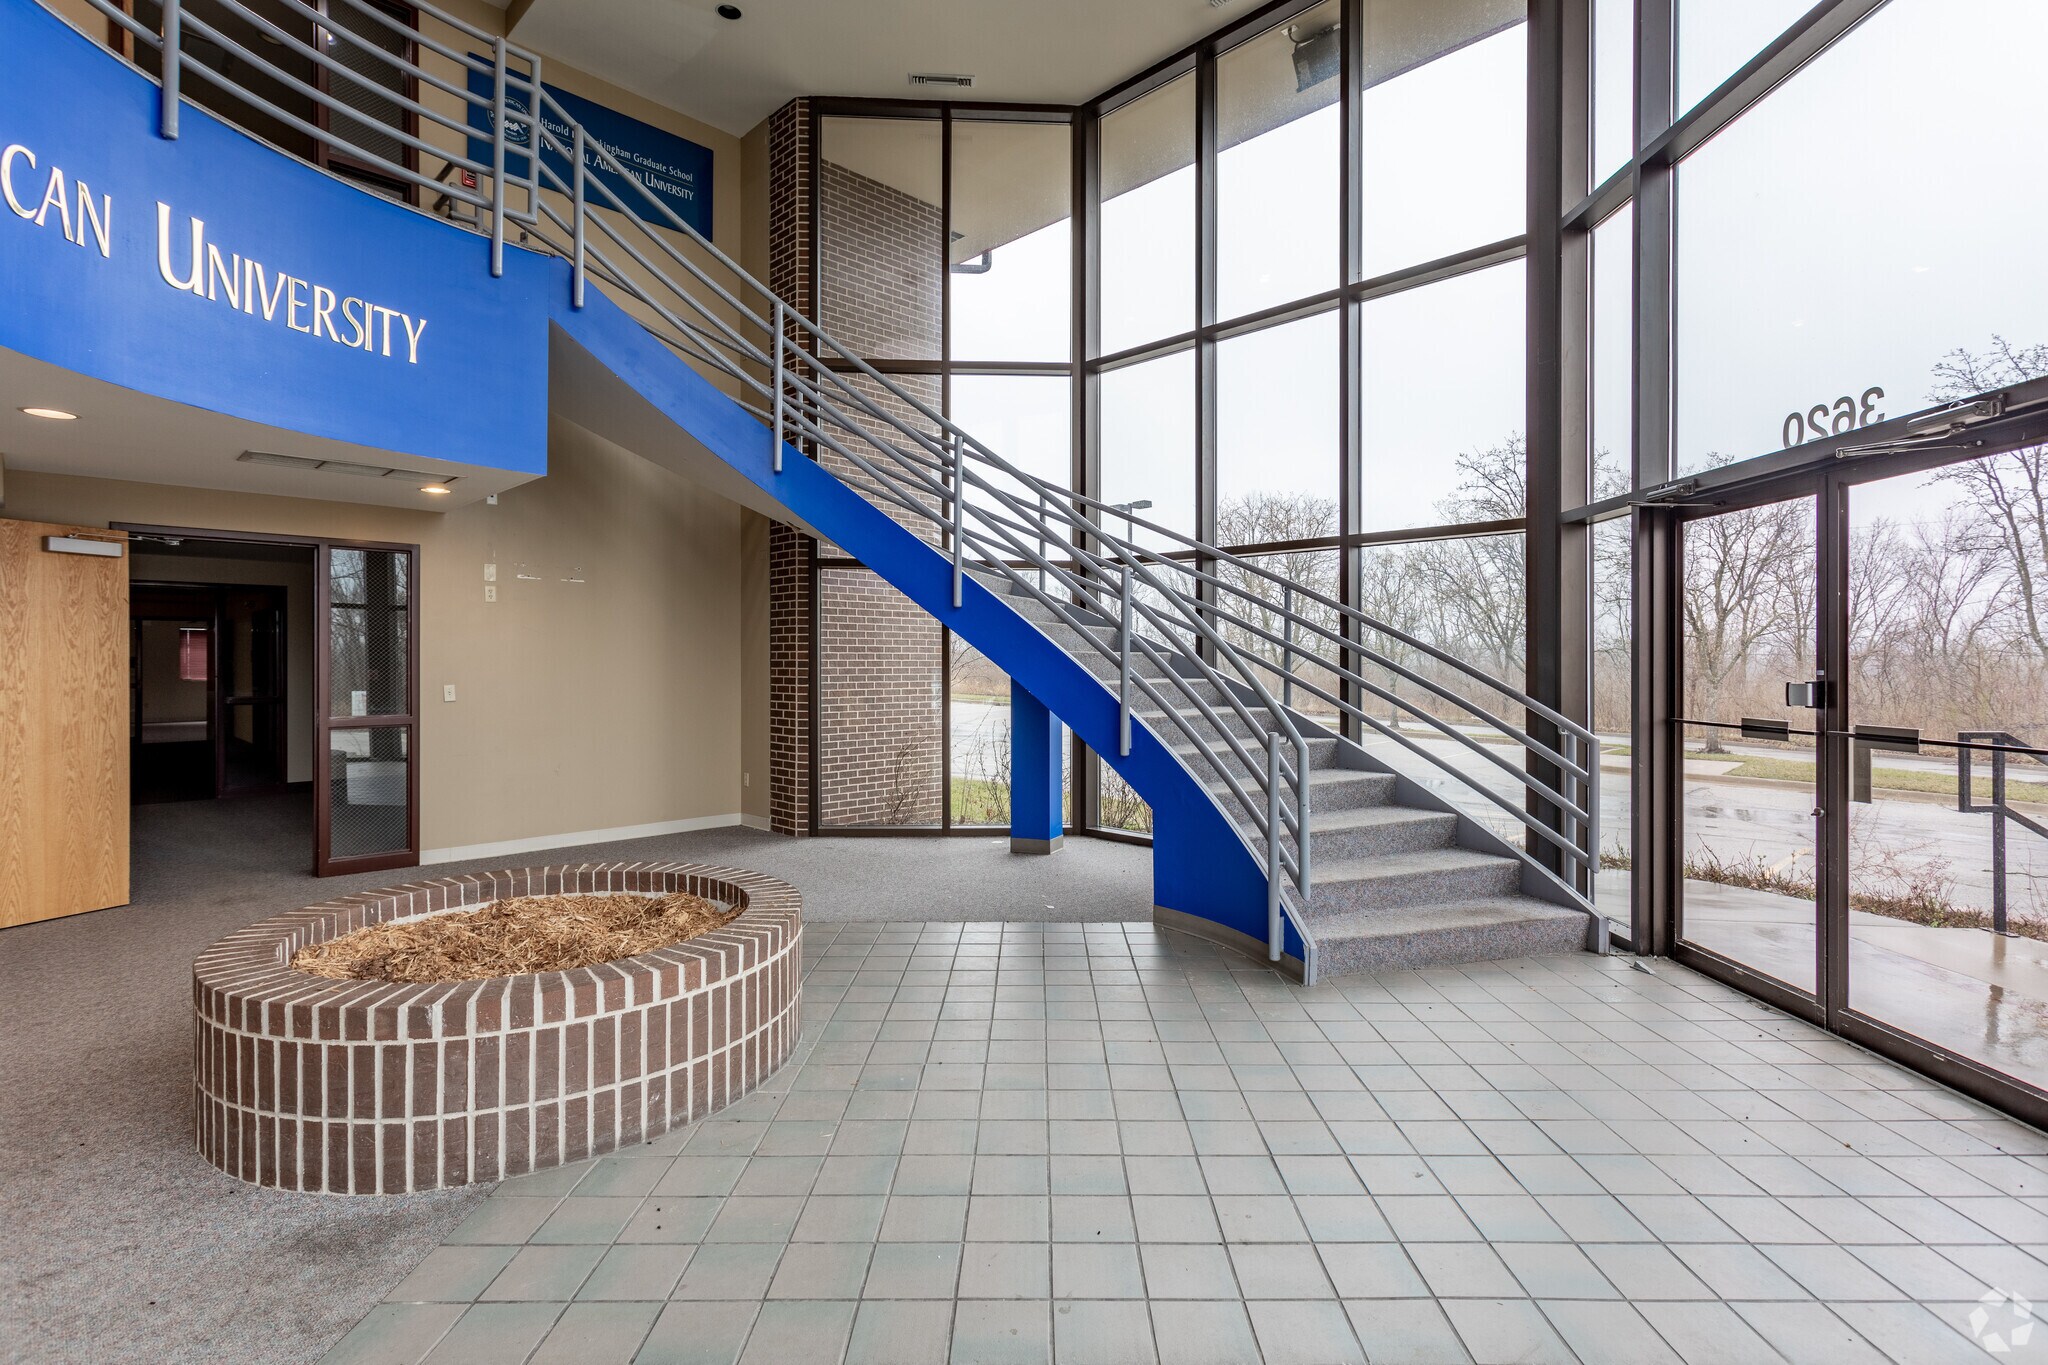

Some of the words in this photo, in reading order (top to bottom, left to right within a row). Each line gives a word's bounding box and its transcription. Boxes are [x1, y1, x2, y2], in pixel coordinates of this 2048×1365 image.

[541, 117, 569, 136] Harold
[633, 153, 667, 173] Graduate
[669, 166, 693, 182] School
[645, 172, 694, 201] UNIVERSITY
[1, 144, 111, 258] CAN
[157, 201, 427, 364] UNIVERSITY
